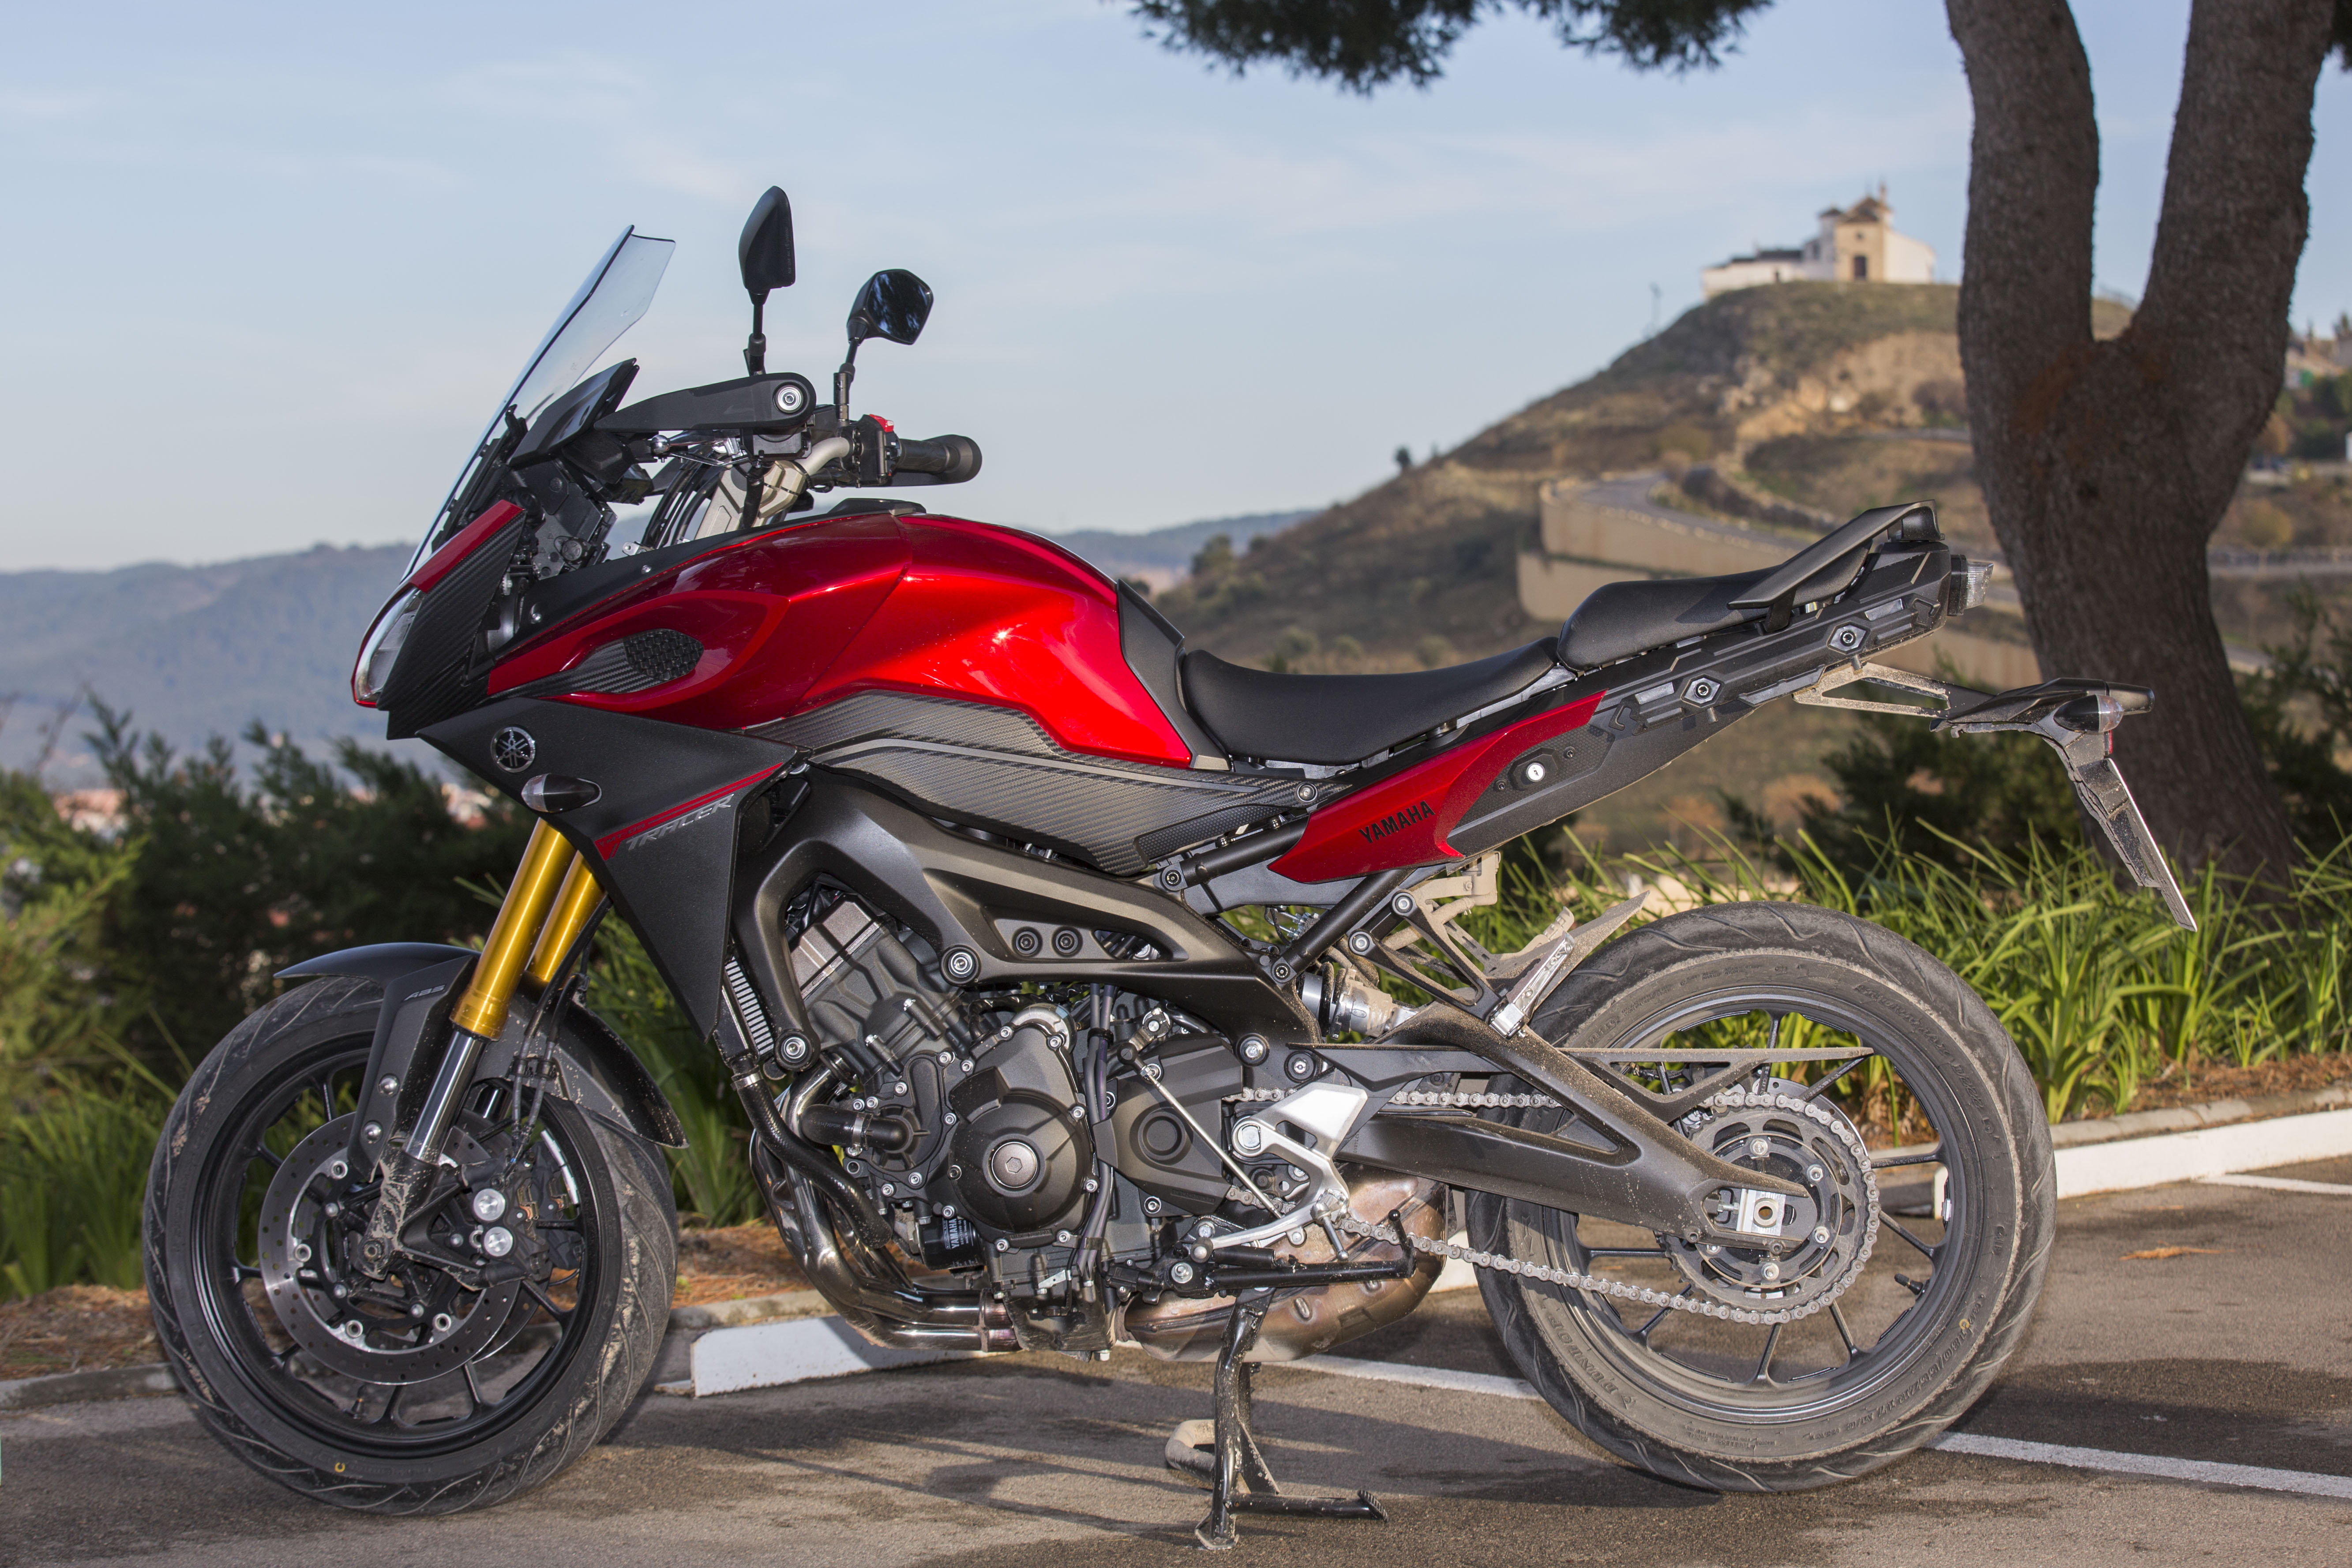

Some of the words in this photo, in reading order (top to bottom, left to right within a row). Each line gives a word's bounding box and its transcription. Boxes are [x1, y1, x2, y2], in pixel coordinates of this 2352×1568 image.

[626, 794, 734, 851] TRACER
[1359, 800, 1435, 844] YAMAHA
[404, 984, 446, 1002] ABS
[949, 1219, 960, 1249] YAMAHA
[1548, 1314, 1619, 1395] DUNLOP
[1876, 1328, 1967, 1417] 180/55ZR17
